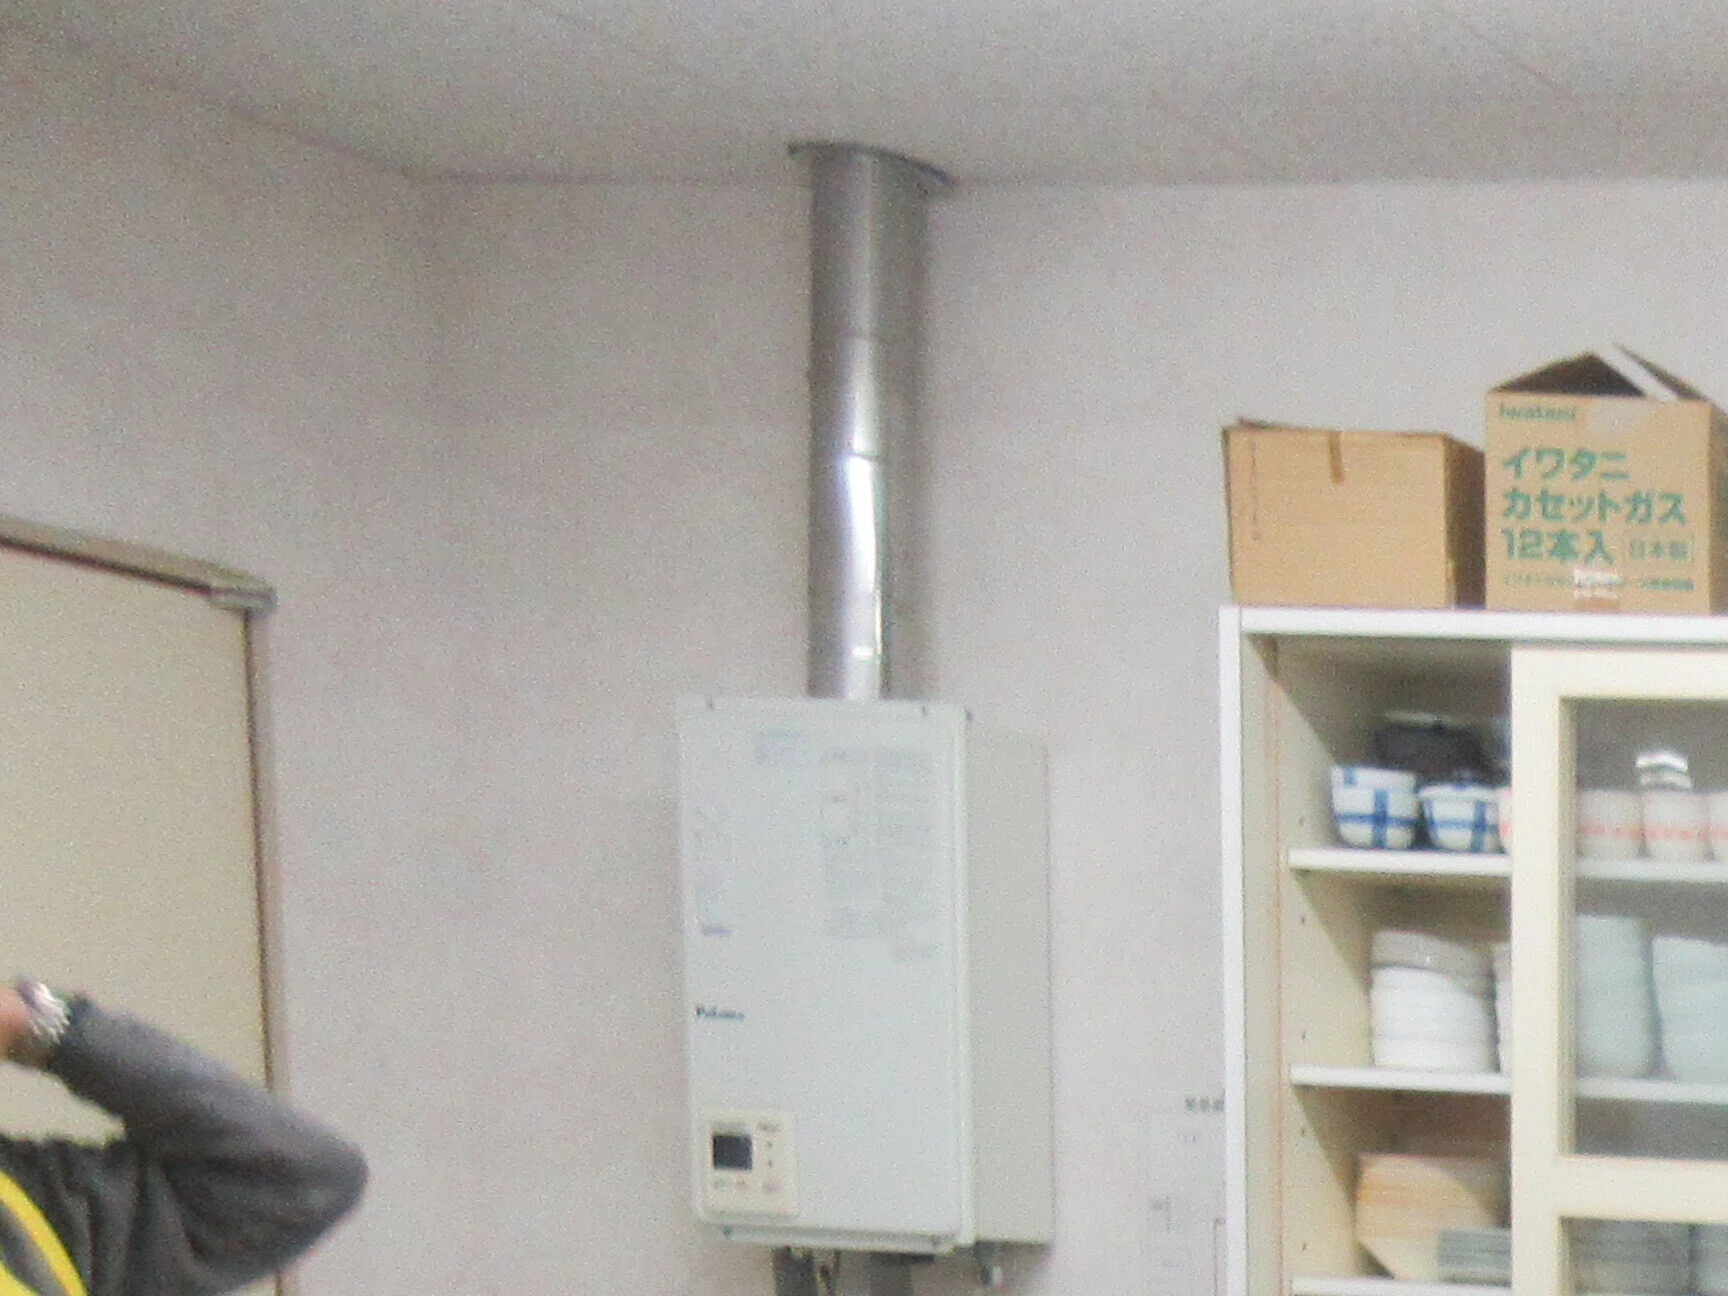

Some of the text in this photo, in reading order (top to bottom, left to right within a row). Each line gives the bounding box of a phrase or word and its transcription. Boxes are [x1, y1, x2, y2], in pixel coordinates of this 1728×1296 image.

[1501, 446, 1631, 482] イワタニ
[1501, 487, 1688, 526] カセットガス
[1500, 527, 1615, 565] 12本入
